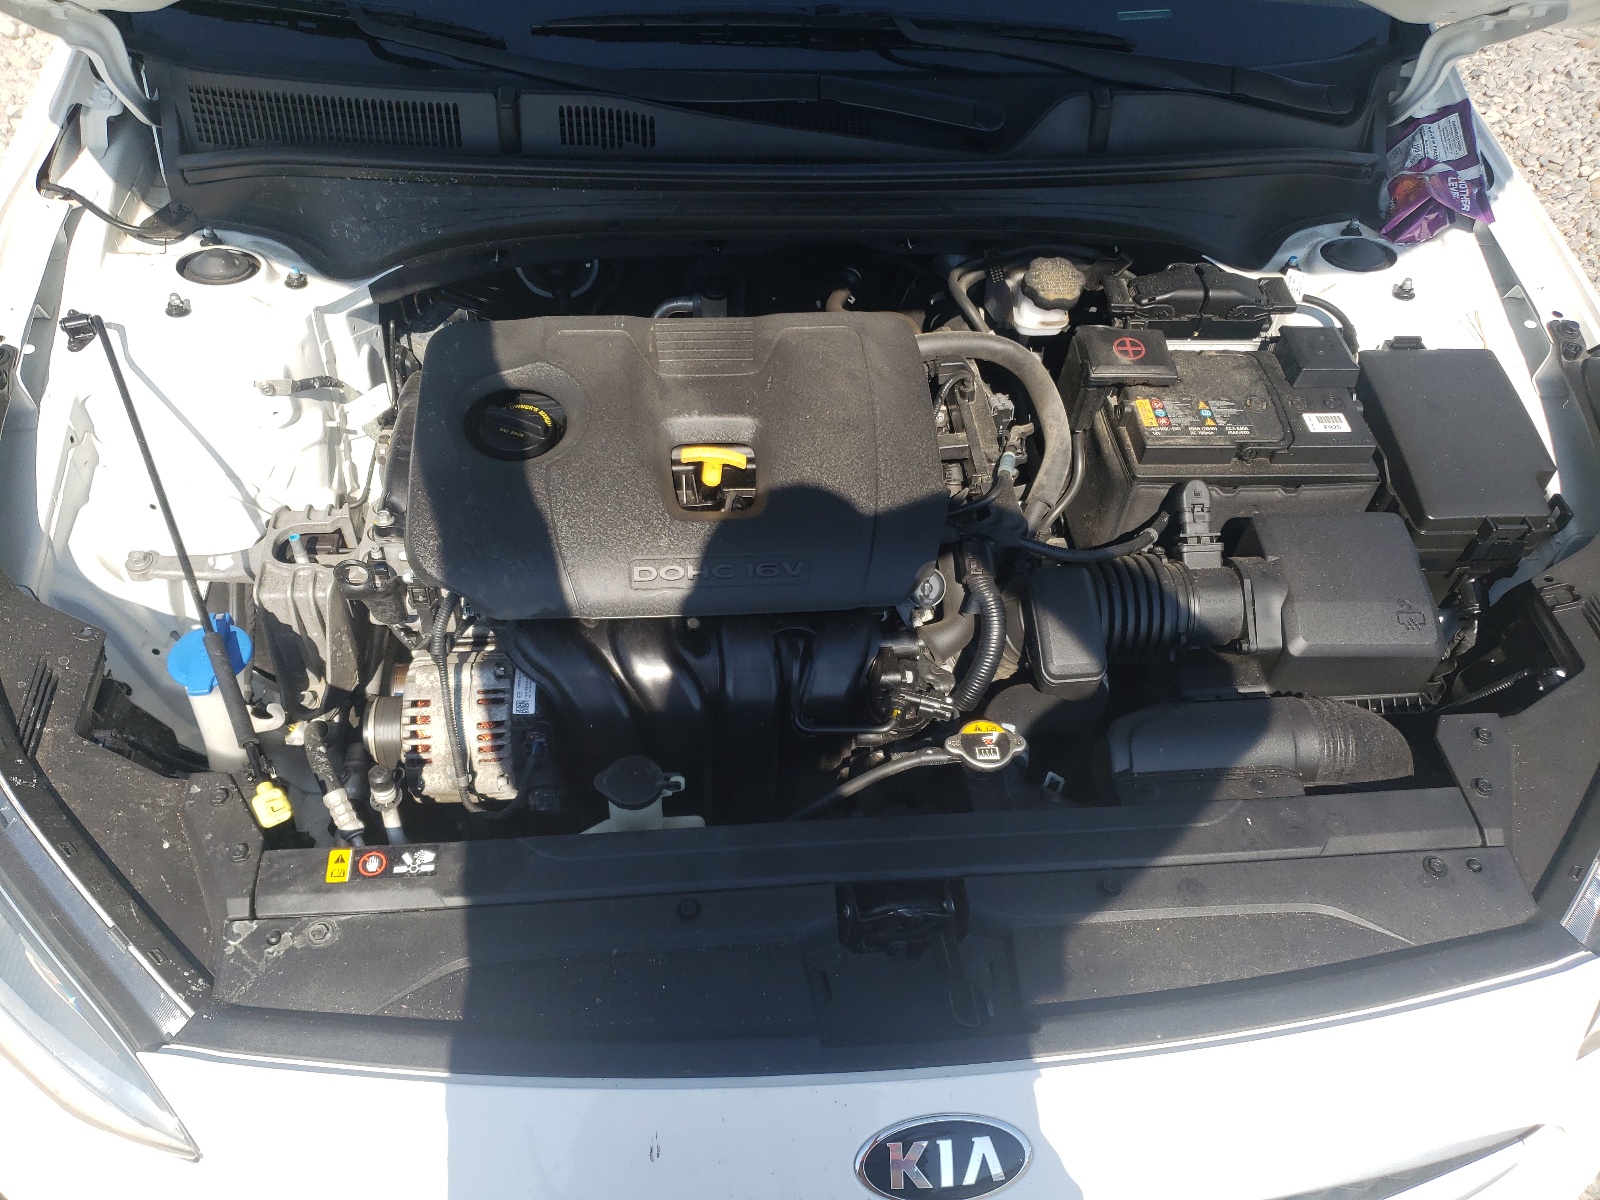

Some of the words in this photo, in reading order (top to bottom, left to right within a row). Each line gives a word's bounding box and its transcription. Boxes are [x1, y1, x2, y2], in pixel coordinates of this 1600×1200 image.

[1458, 177, 1471, 212] NOTHER
[633, 564, 735, 582] DOHC
[746, 561, 806, 578] 16V
[886, 1135, 1006, 1190] KIA
